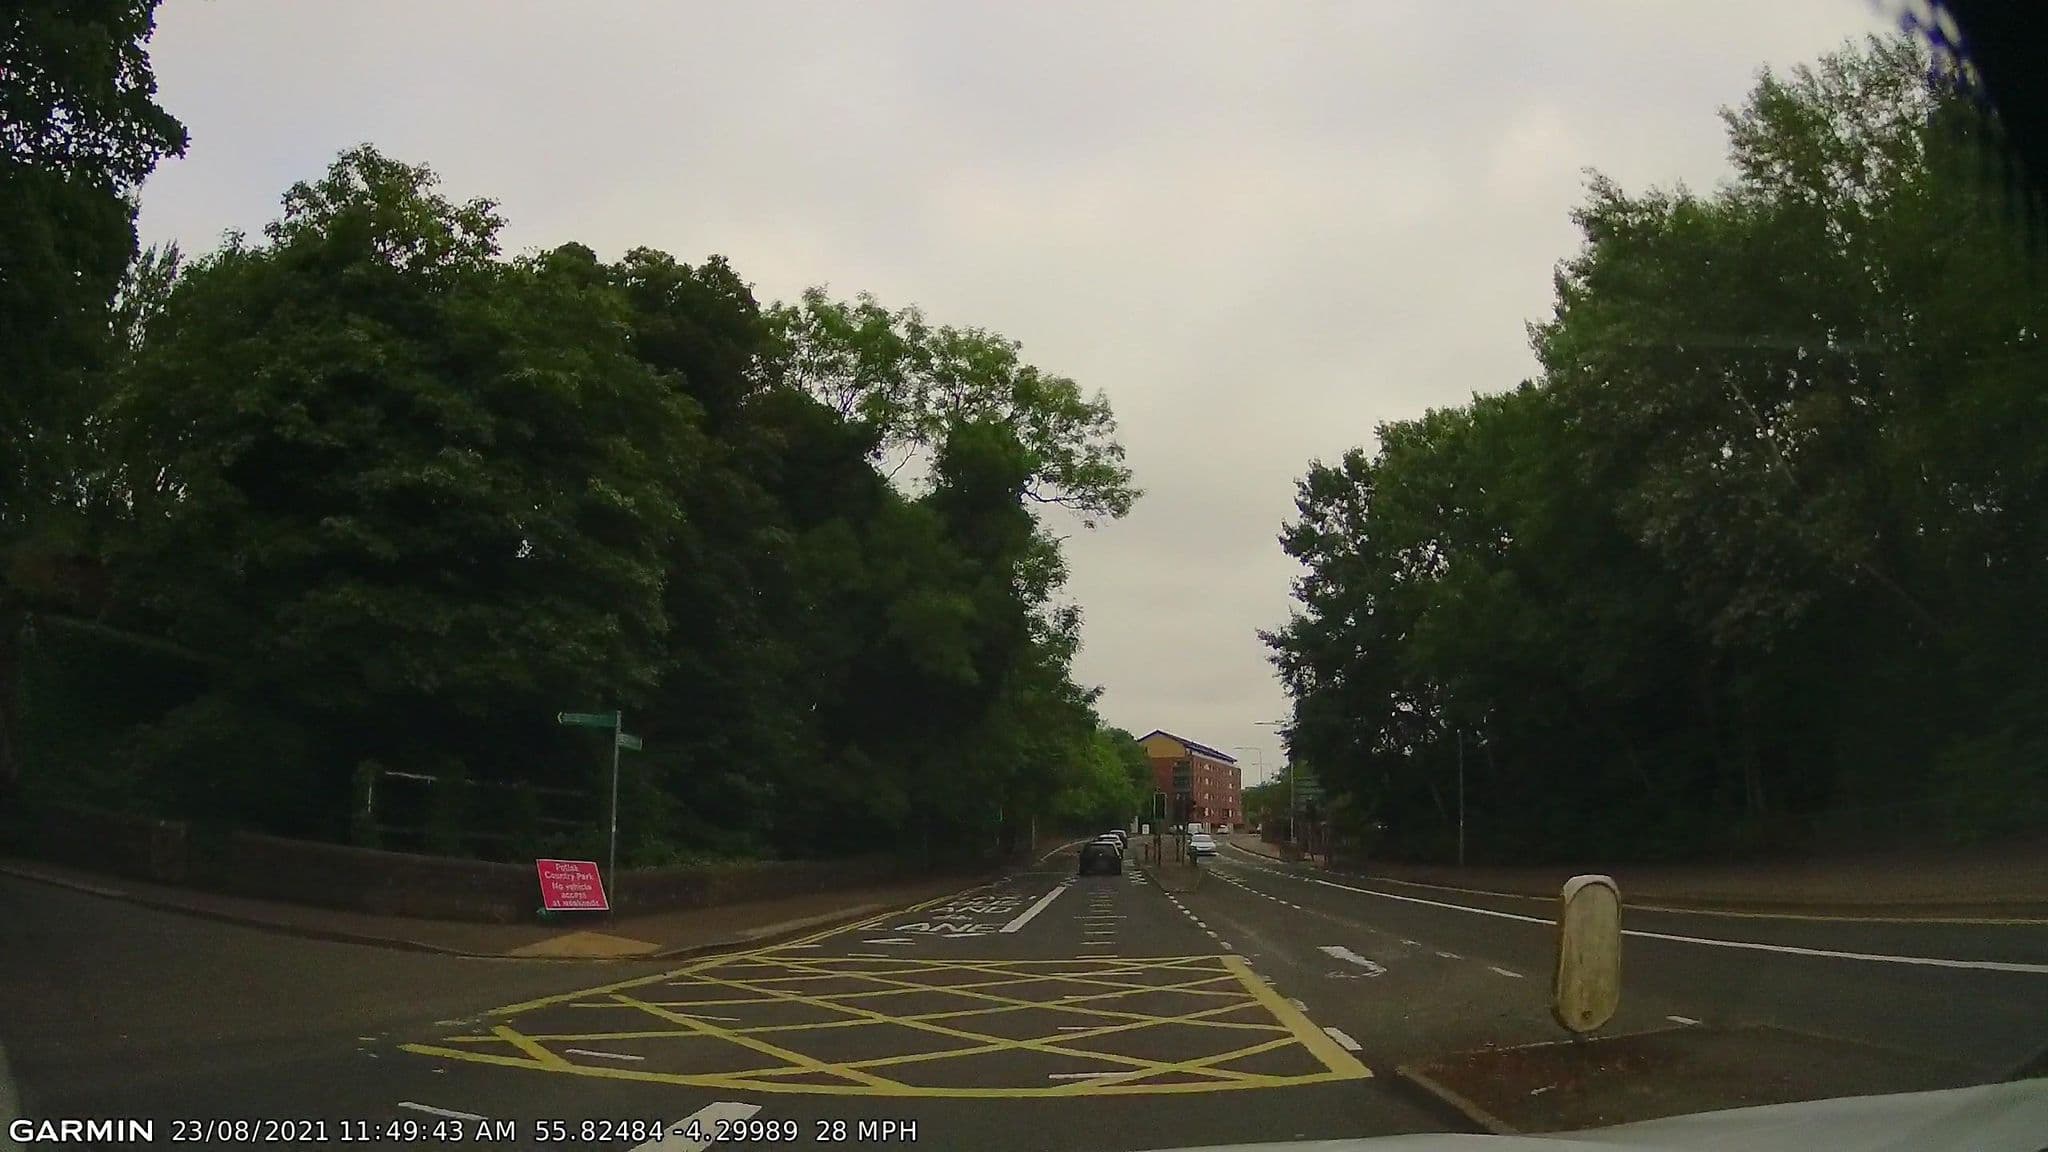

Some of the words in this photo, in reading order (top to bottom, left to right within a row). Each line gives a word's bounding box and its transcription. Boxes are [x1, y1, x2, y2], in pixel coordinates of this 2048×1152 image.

[544, 871, 575, 881] Country
[551, 881, 564, 890] No
[566, 883, 593, 891] vehicle
[929, 906, 1012, 914] AND
